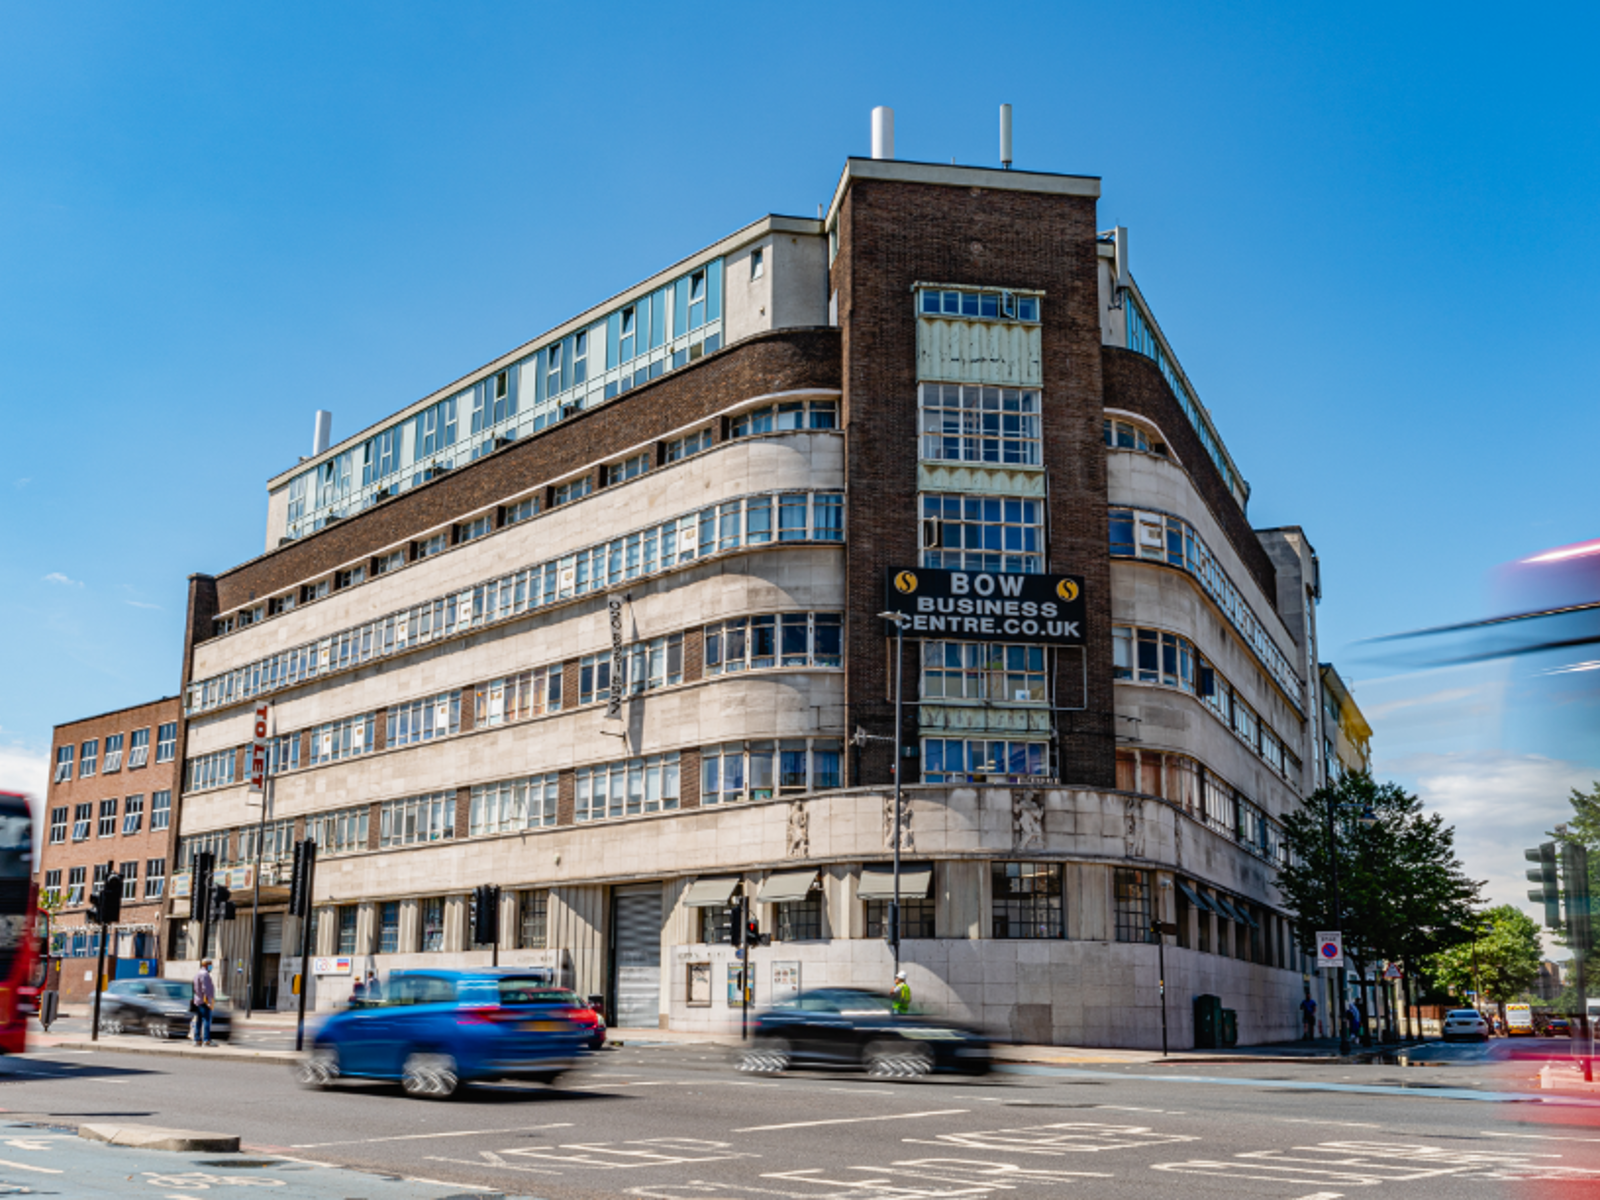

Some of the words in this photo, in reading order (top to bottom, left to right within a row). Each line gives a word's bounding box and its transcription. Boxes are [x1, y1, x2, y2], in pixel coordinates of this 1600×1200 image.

[951, 572, 1025, 597] BOW
[917, 597, 1058, 618] BUSINESS
[895, 613, 1081, 638] CENTRE.CO.UK
[255, 705, 268, 738] TO
[251, 745, 265, 789] LET
[900, 1122, 1202, 1156] KEEP
[424, 1137, 763, 1176] KEEP
